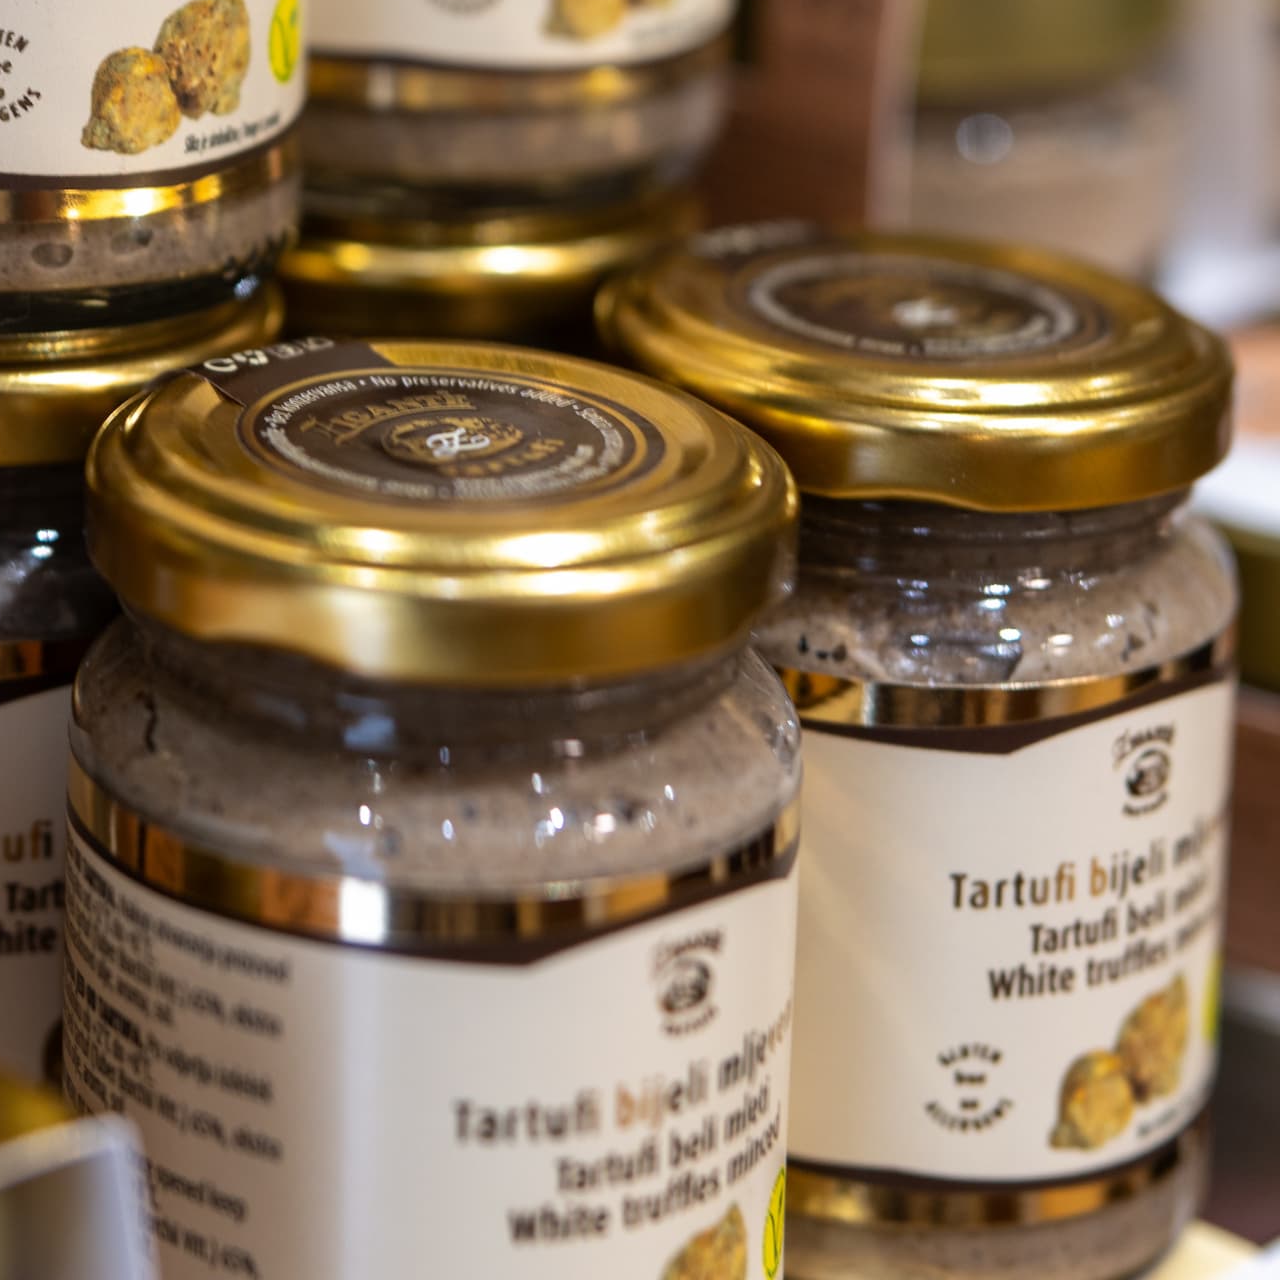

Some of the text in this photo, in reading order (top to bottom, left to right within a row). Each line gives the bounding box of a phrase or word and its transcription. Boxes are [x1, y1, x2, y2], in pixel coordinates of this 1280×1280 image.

[401, 376, 519, 396] preservatives
[949, 862, 1076, 910] Tartufi
[1089, 836, 1166, 900] bijeli
[5, 880, 66, 914] Tart
[1030, 909, 1118, 954] Tartufi
[988, 961, 1076, 1001] White
[453, 1086, 600, 1144] Tartufi
[507, 1202, 609, 1245] White
